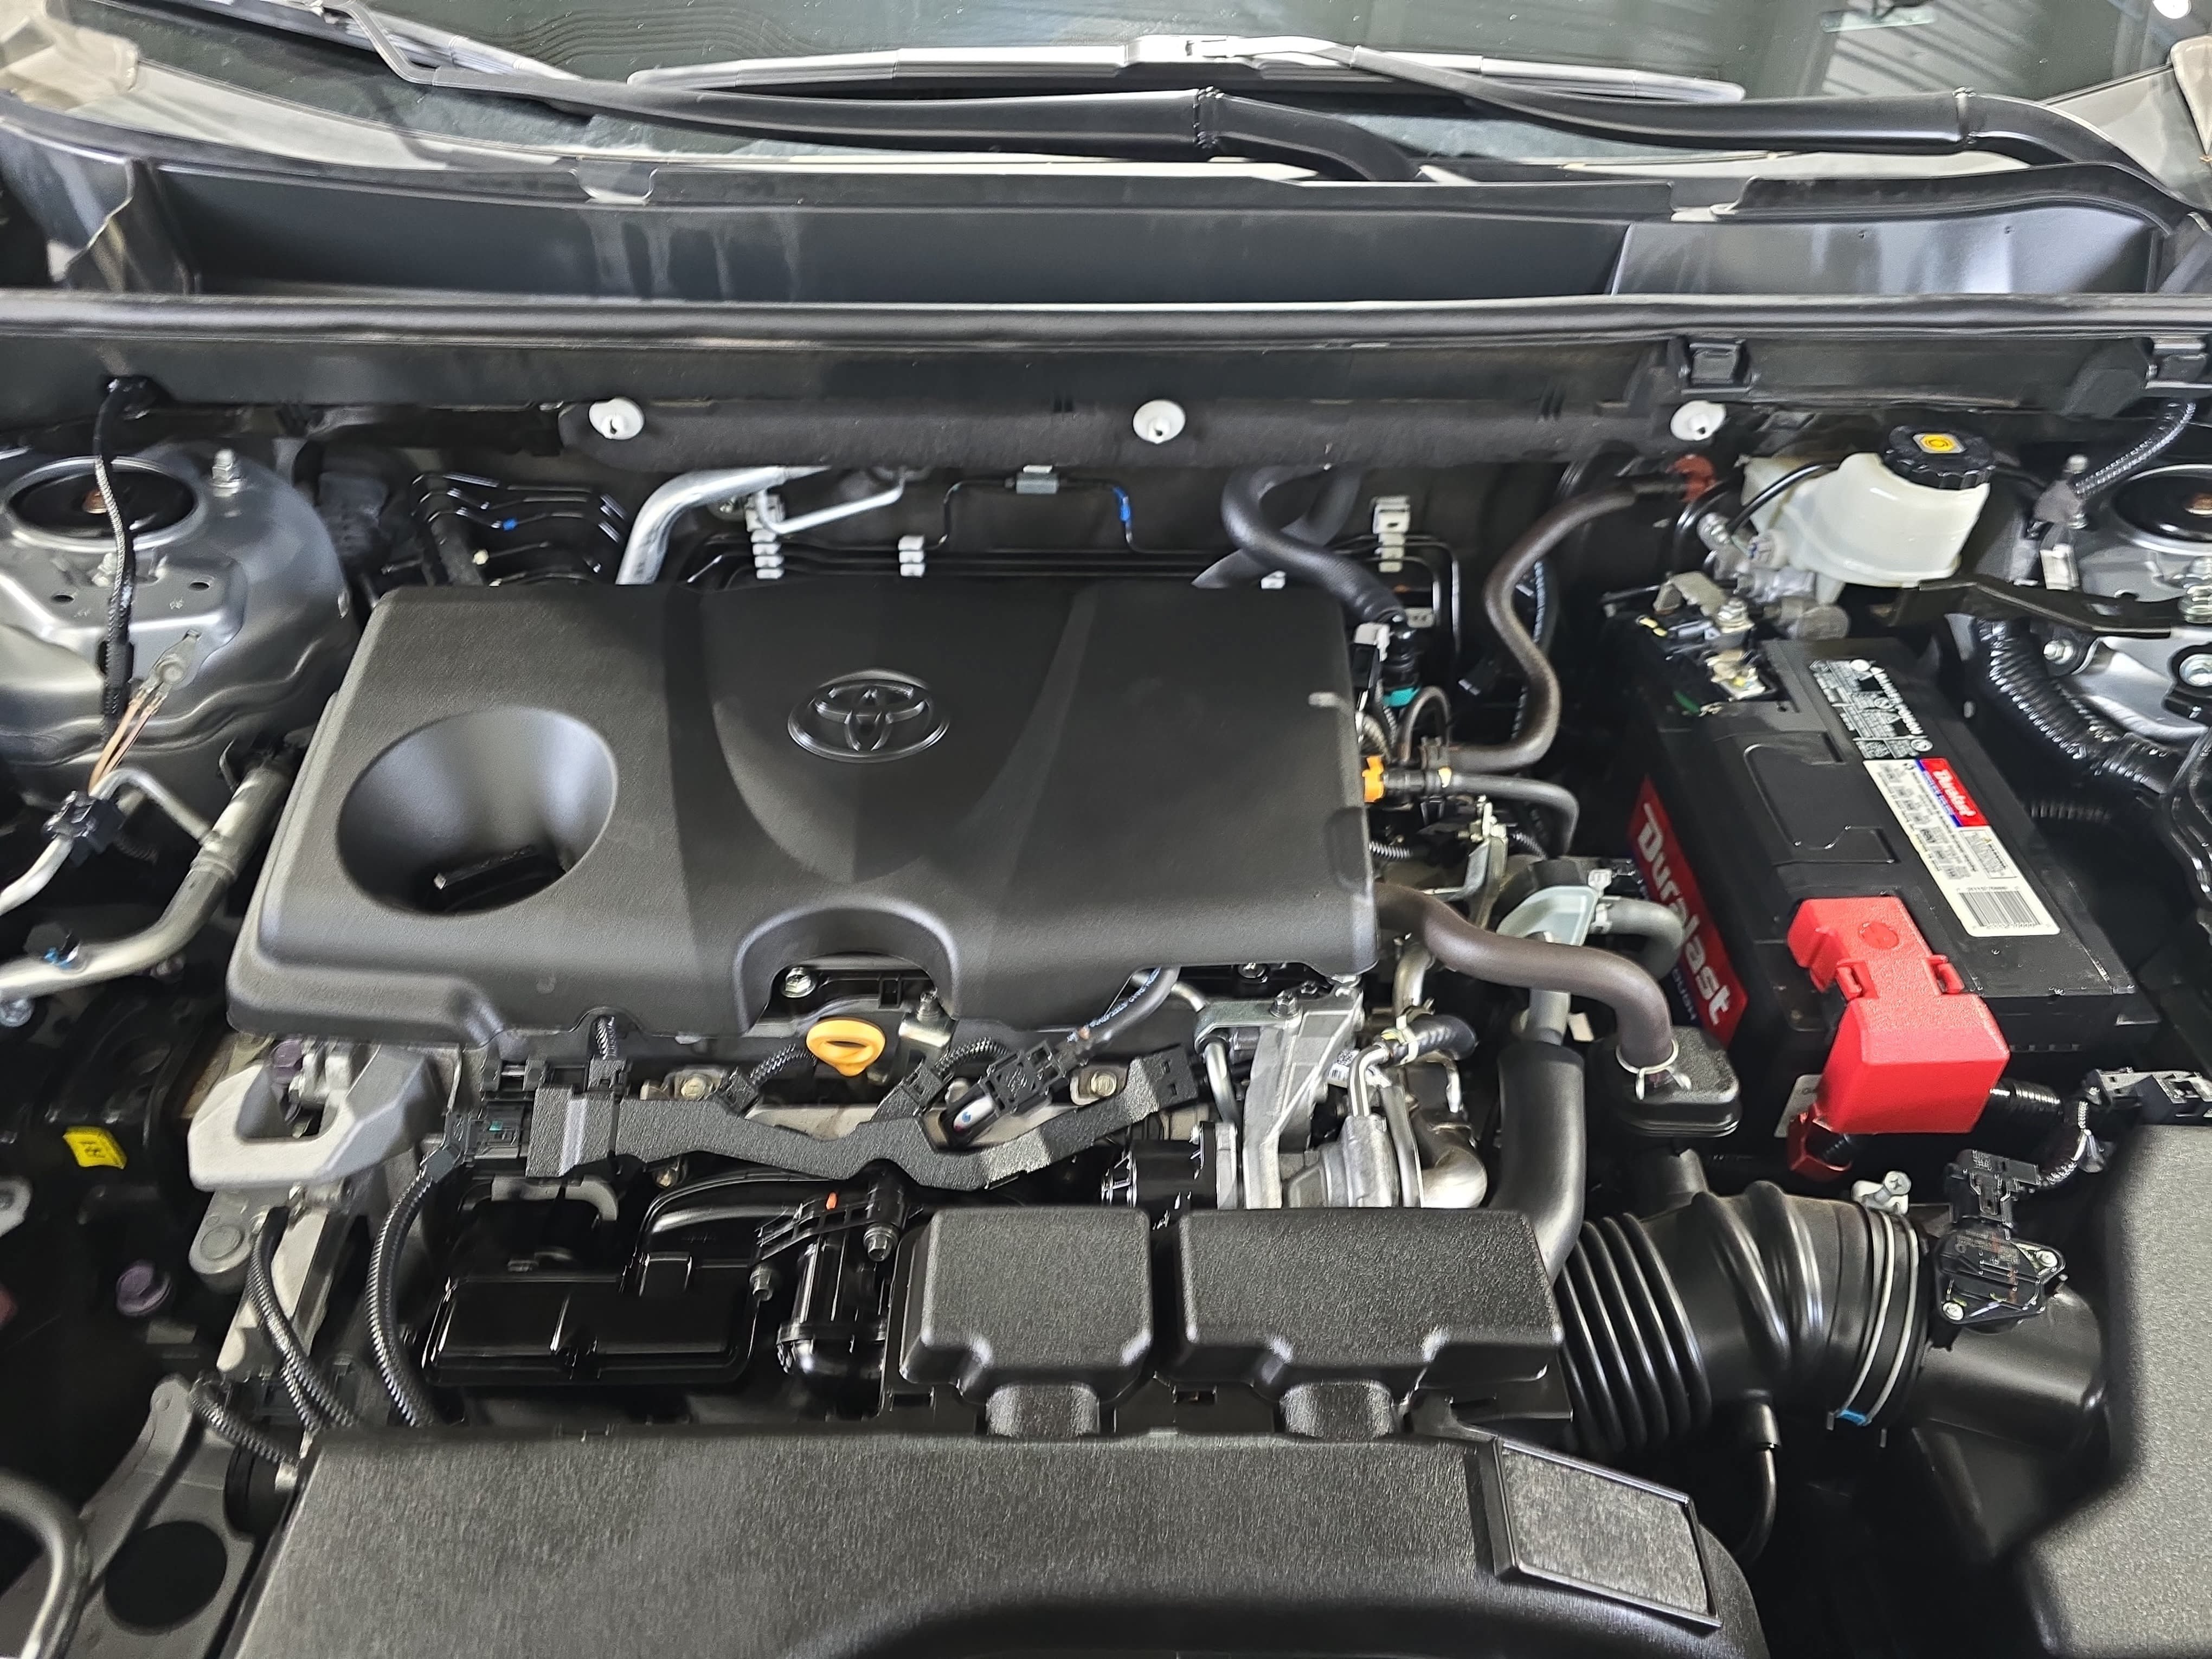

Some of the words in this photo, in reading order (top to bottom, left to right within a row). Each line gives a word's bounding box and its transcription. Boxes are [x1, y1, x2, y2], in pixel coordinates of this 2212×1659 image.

[1932, 768, 1977, 817] Duralast
[1637, 802, 1731, 1026] Duralast
[1671, 967, 1697, 1020] OUGH
